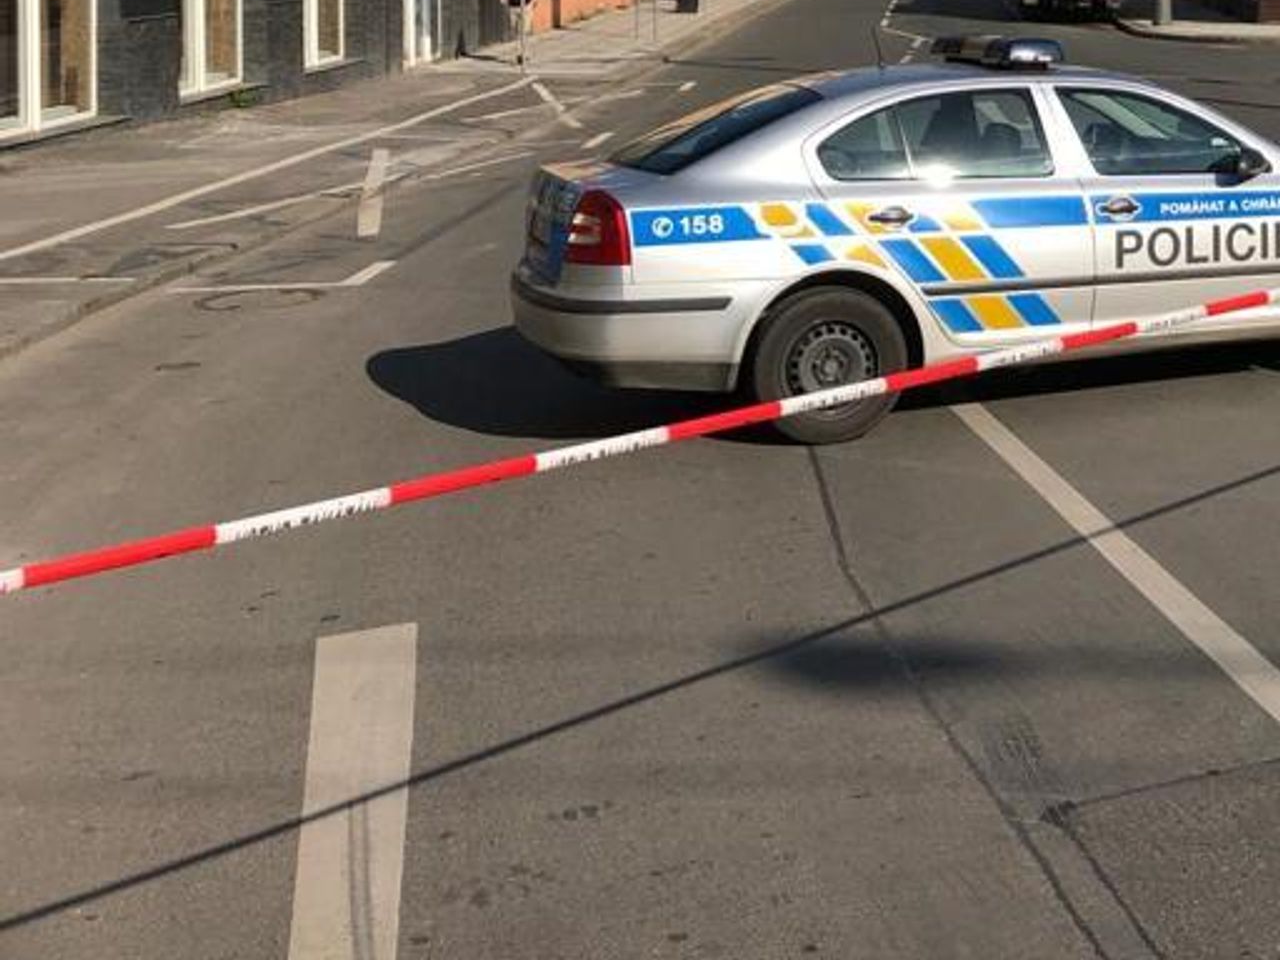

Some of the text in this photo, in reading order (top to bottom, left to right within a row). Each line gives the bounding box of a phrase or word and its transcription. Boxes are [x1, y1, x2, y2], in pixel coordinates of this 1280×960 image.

[1160, 199, 1225, 215] POMÁHAT
[1229, 201, 1239, 212] A
[680, 214, 724, 235] 158
